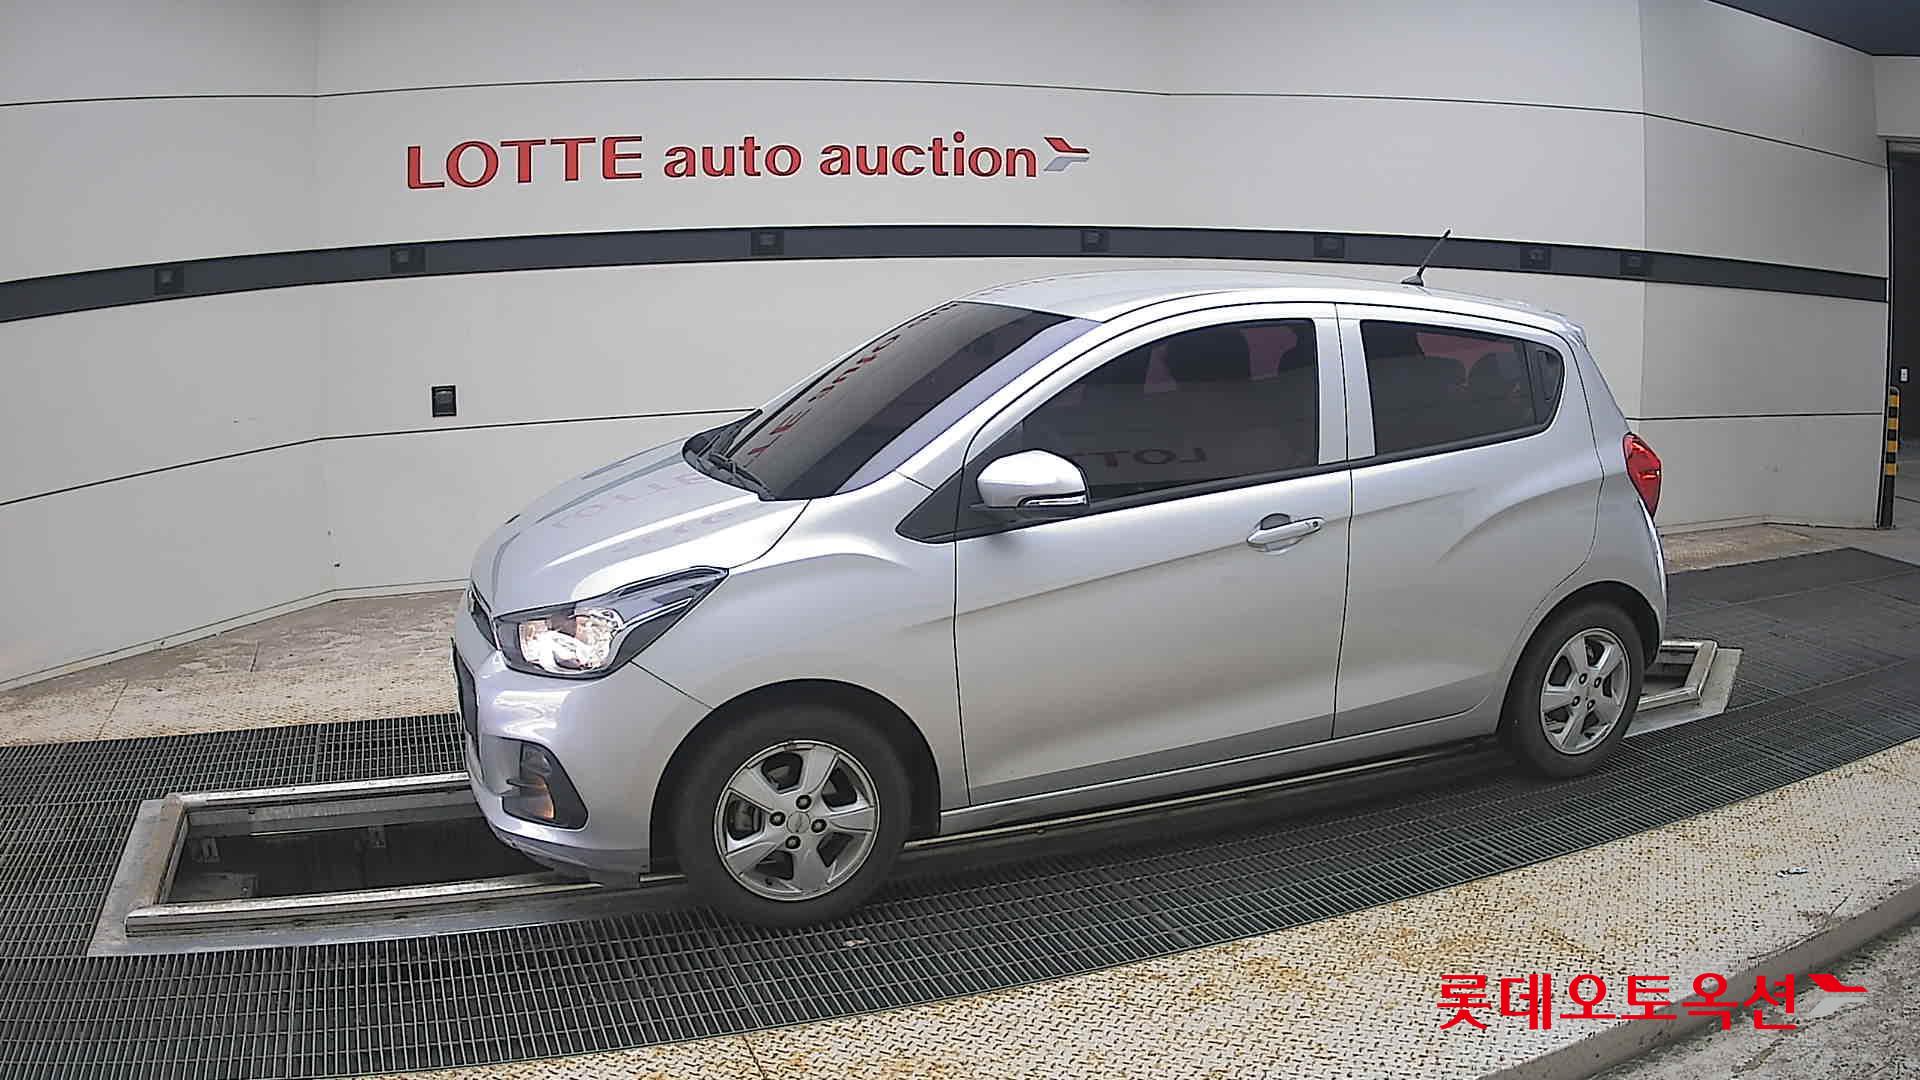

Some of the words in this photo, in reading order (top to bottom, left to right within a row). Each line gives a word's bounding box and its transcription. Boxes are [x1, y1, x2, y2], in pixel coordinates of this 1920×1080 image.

[407, 136, 641, 189] LOTTE
[664, 137, 801, 177] auto
[819, 131, 1037, 177] auction
